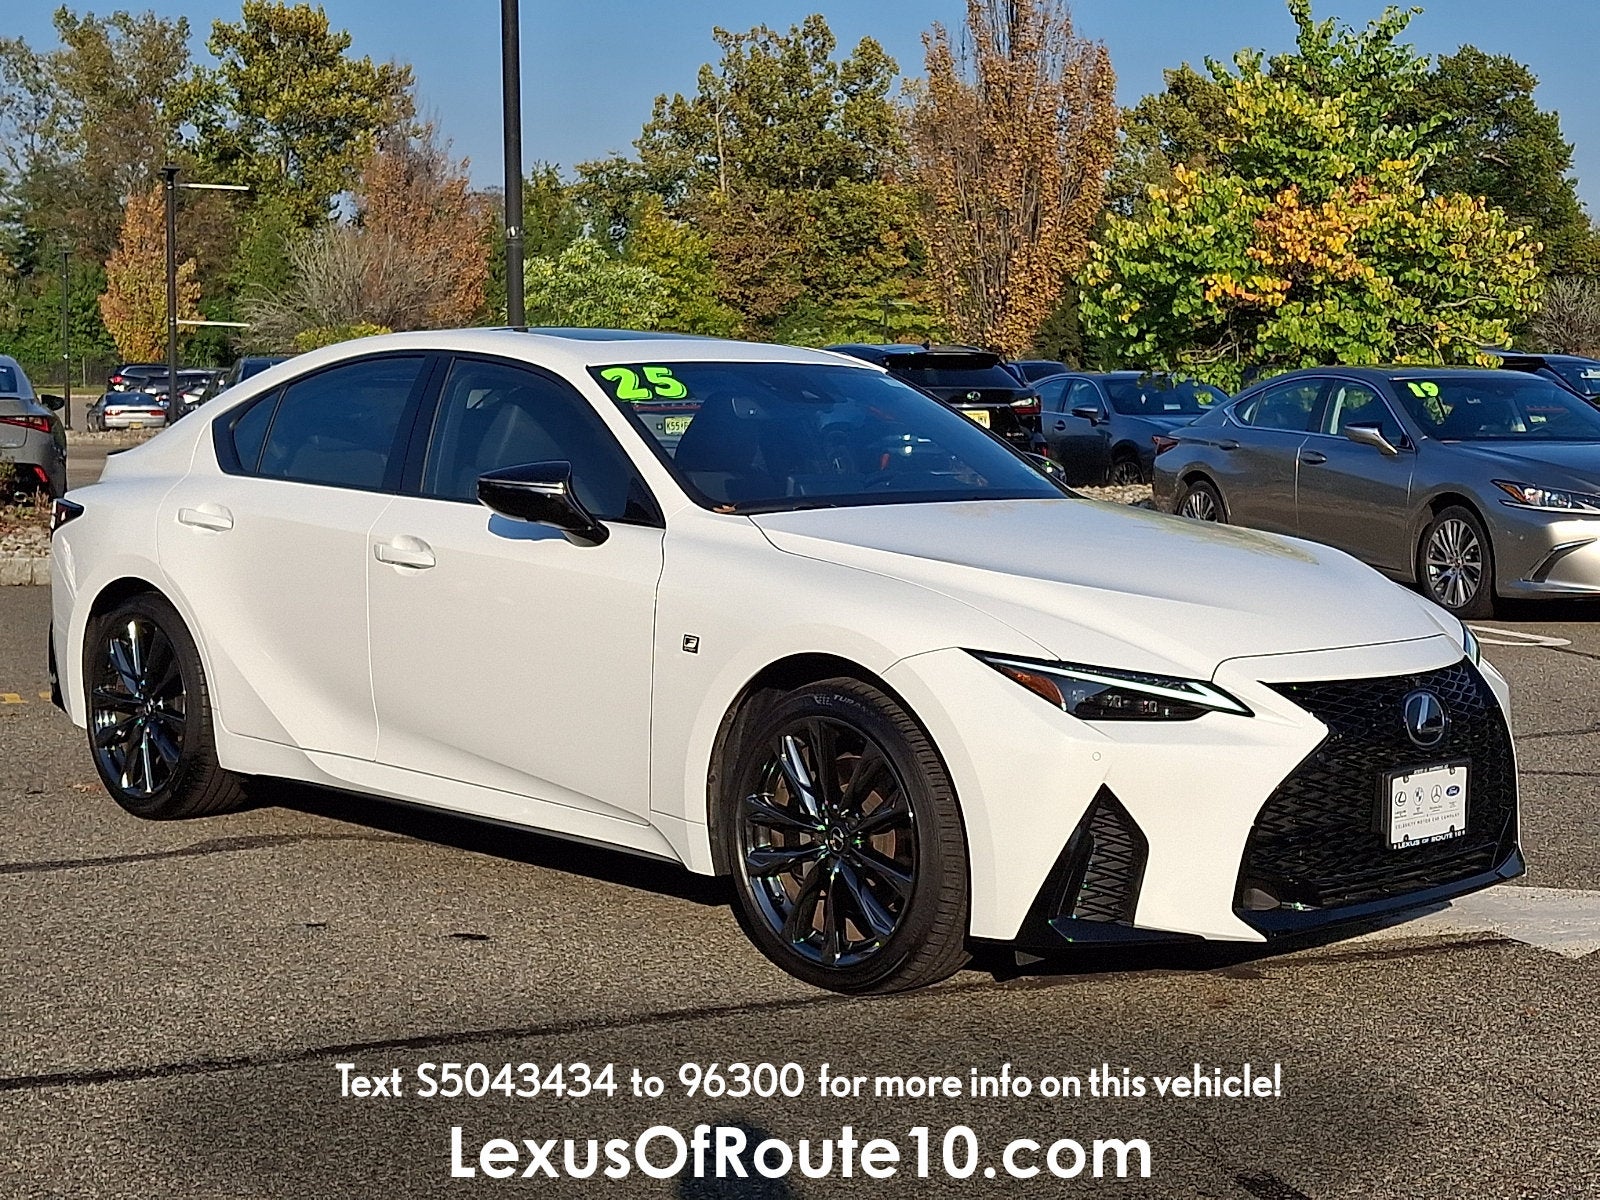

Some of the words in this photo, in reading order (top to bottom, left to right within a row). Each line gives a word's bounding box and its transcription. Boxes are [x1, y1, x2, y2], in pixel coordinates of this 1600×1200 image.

[601, 366, 687, 400] 25
[1407, 381, 1439, 398] 19
[1398, 839, 1420, 849] LEXUS
[1431, 832, 1453, 842] ROUTE
